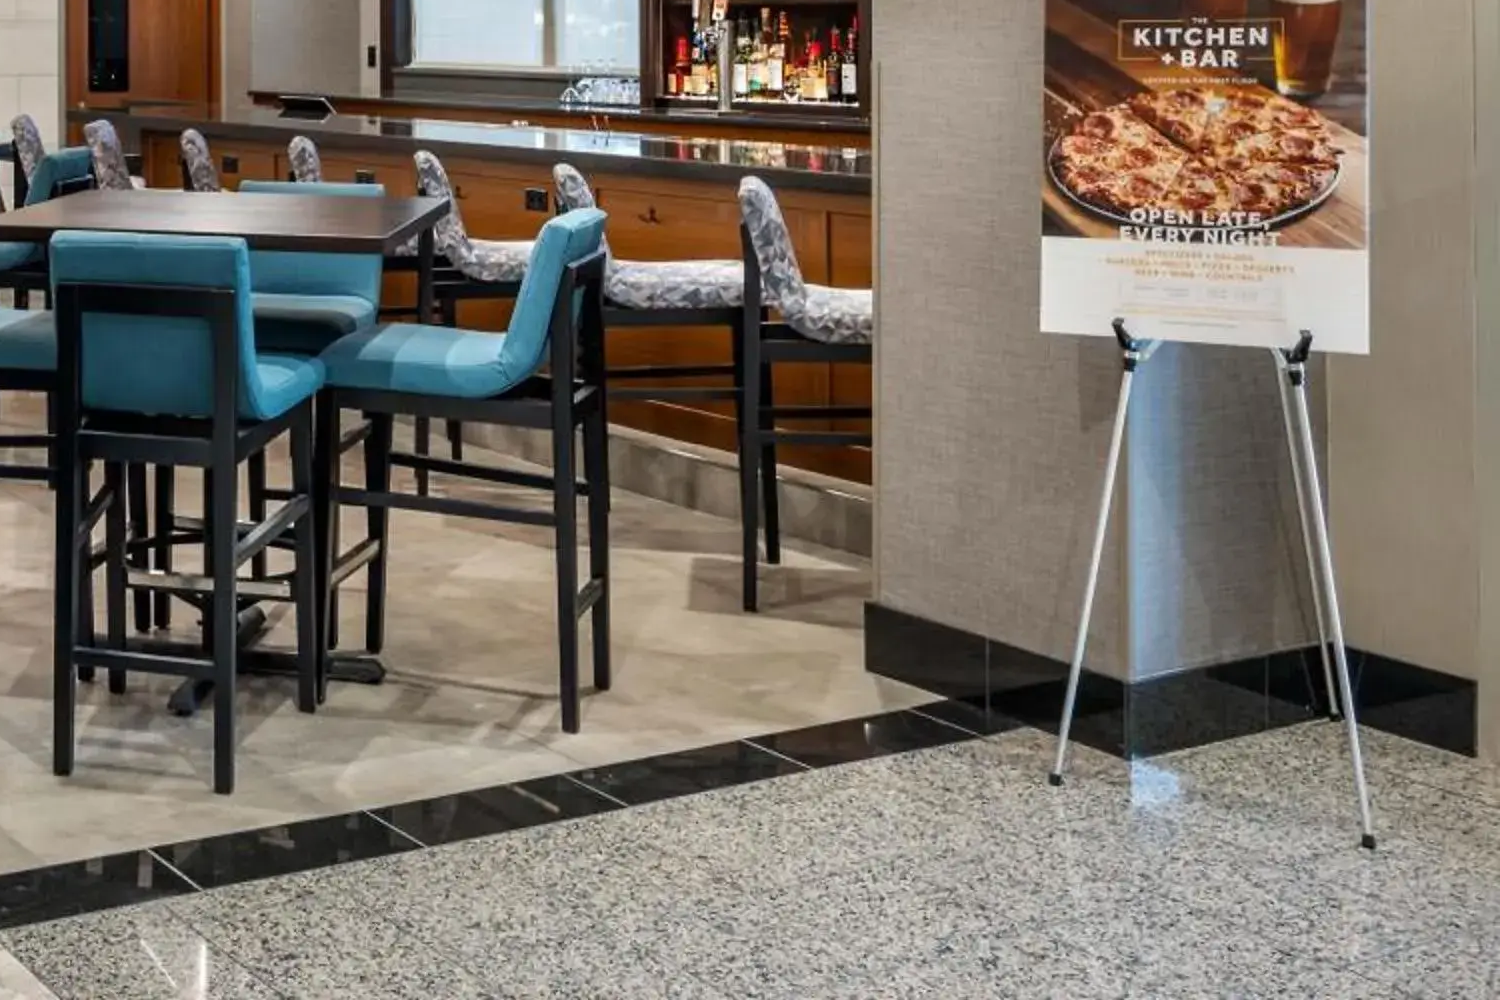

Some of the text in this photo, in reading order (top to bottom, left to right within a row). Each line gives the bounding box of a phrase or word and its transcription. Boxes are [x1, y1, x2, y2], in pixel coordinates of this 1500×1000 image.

[1133, 26, 1269, 47] KITCHEN
[1180, 49, 1239, 68] BAR
[1129, 208, 1270, 230] OPEN LATE,
[1119, 225, 1282, 247] EVERY NIGHT
